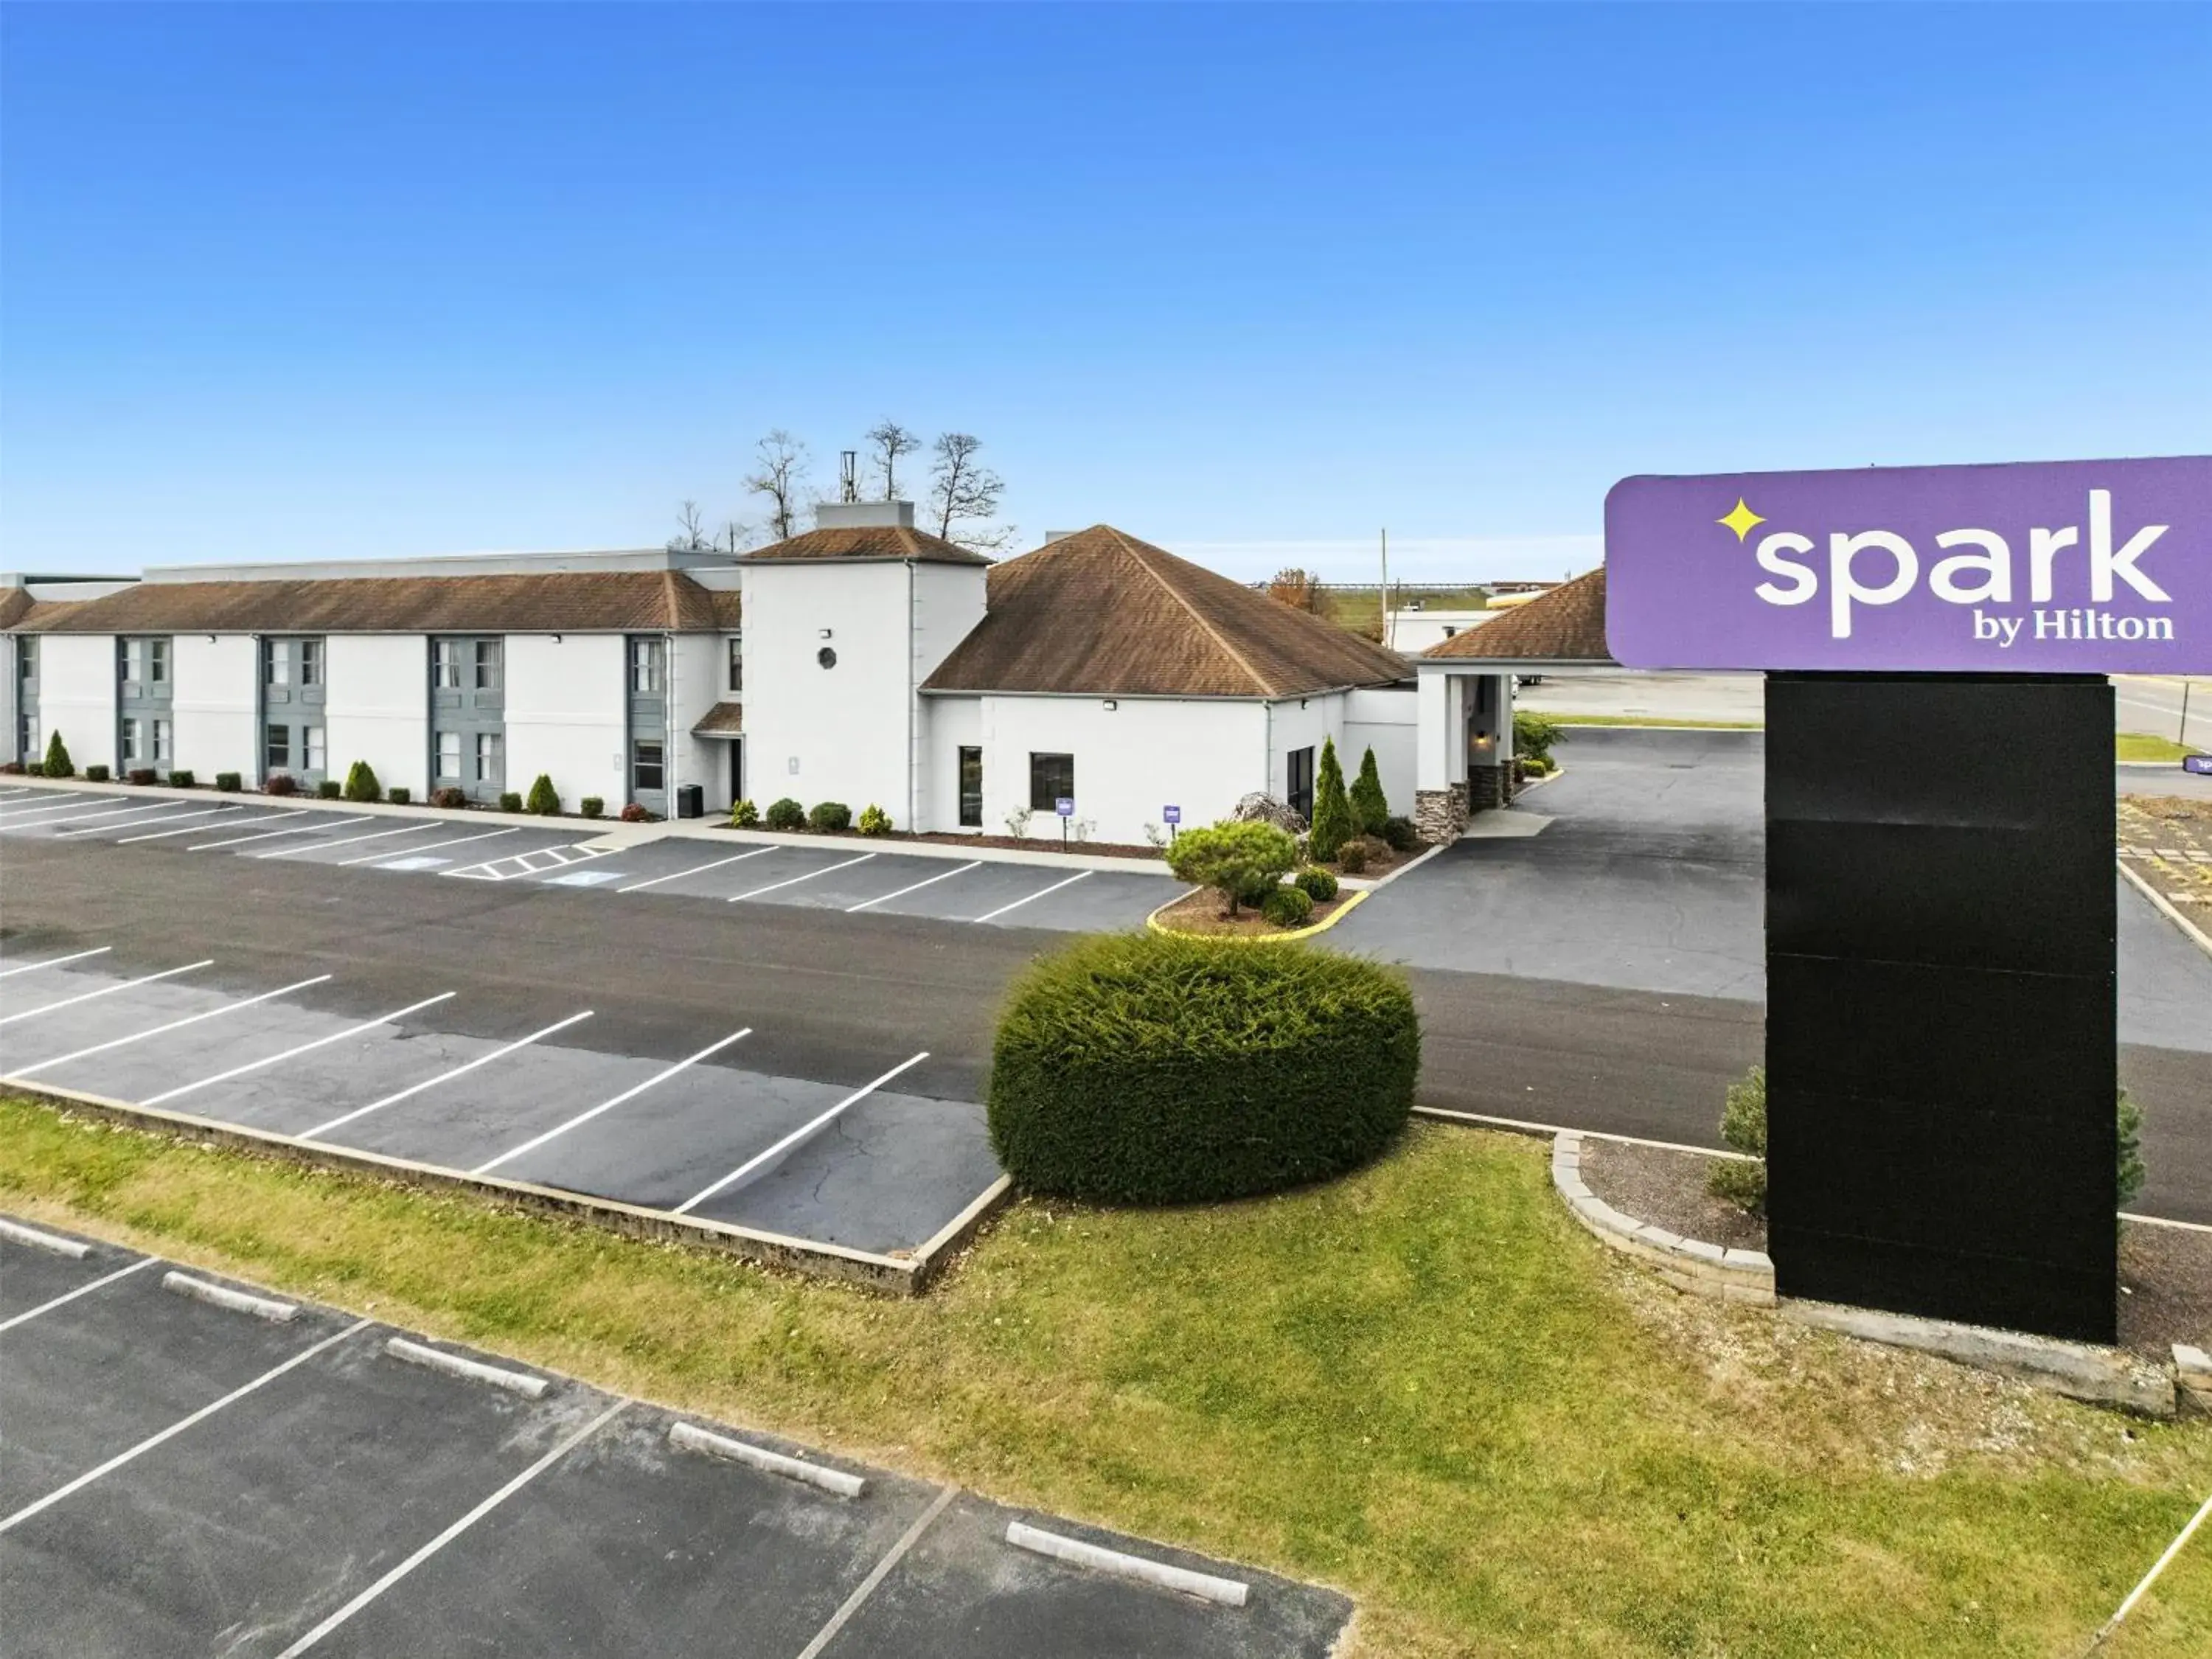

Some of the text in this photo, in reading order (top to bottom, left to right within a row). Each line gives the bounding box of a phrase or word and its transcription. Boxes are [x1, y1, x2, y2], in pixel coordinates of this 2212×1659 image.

[1755, 489, 2172, 639] spark
[1974, 608, 2174, 648] by Hilton
